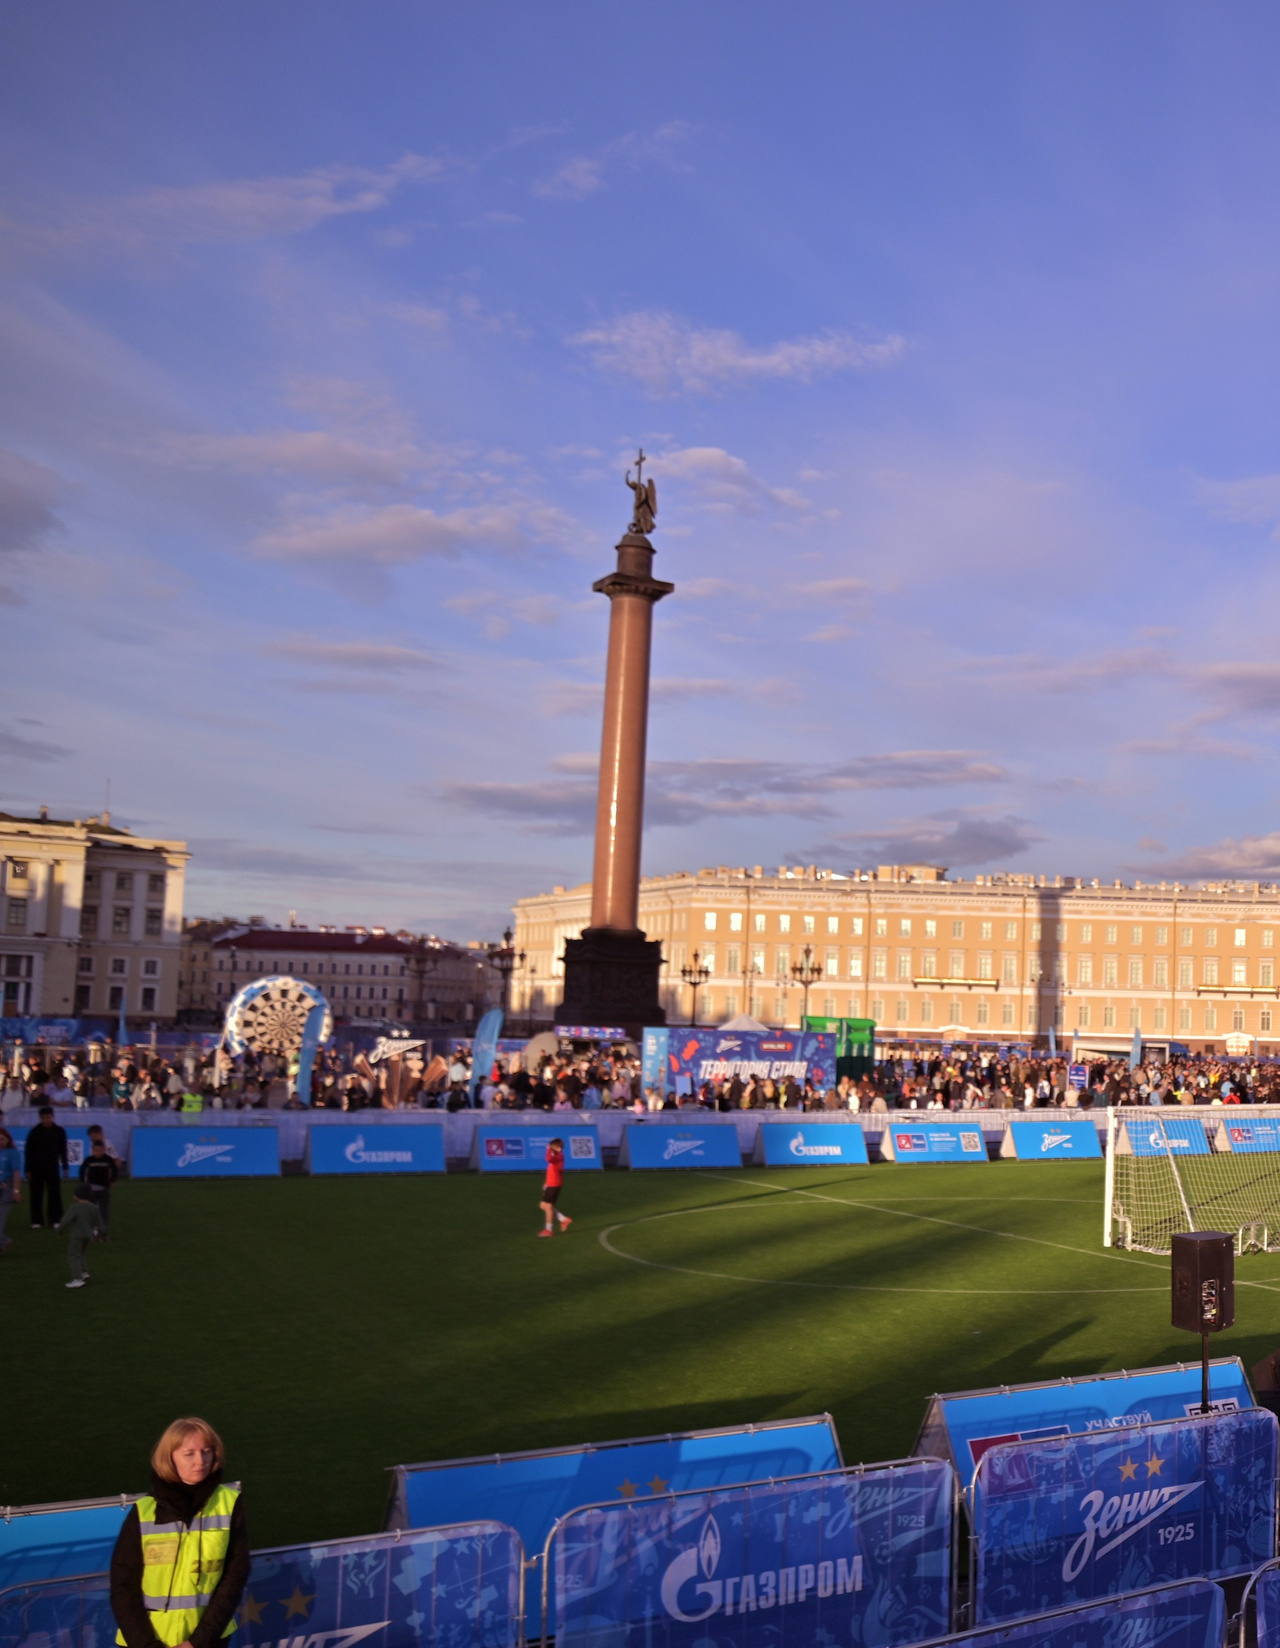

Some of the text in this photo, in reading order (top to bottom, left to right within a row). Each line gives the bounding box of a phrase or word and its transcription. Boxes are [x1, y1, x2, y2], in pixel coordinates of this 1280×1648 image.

[699, 1060, 808, 1080] ТЕРРИТОРИЯ СТИЛЯ
[1085, 1410, 1153, 1432] УЧАСТВУЙ
[896, 1514, 926, 1529] 1925
[1157, 1523, 1195, 1546] 1925
[556, 1573, 583, 1588] 925
[724, 1554, 864, 1617] ГАЗПРОМ
